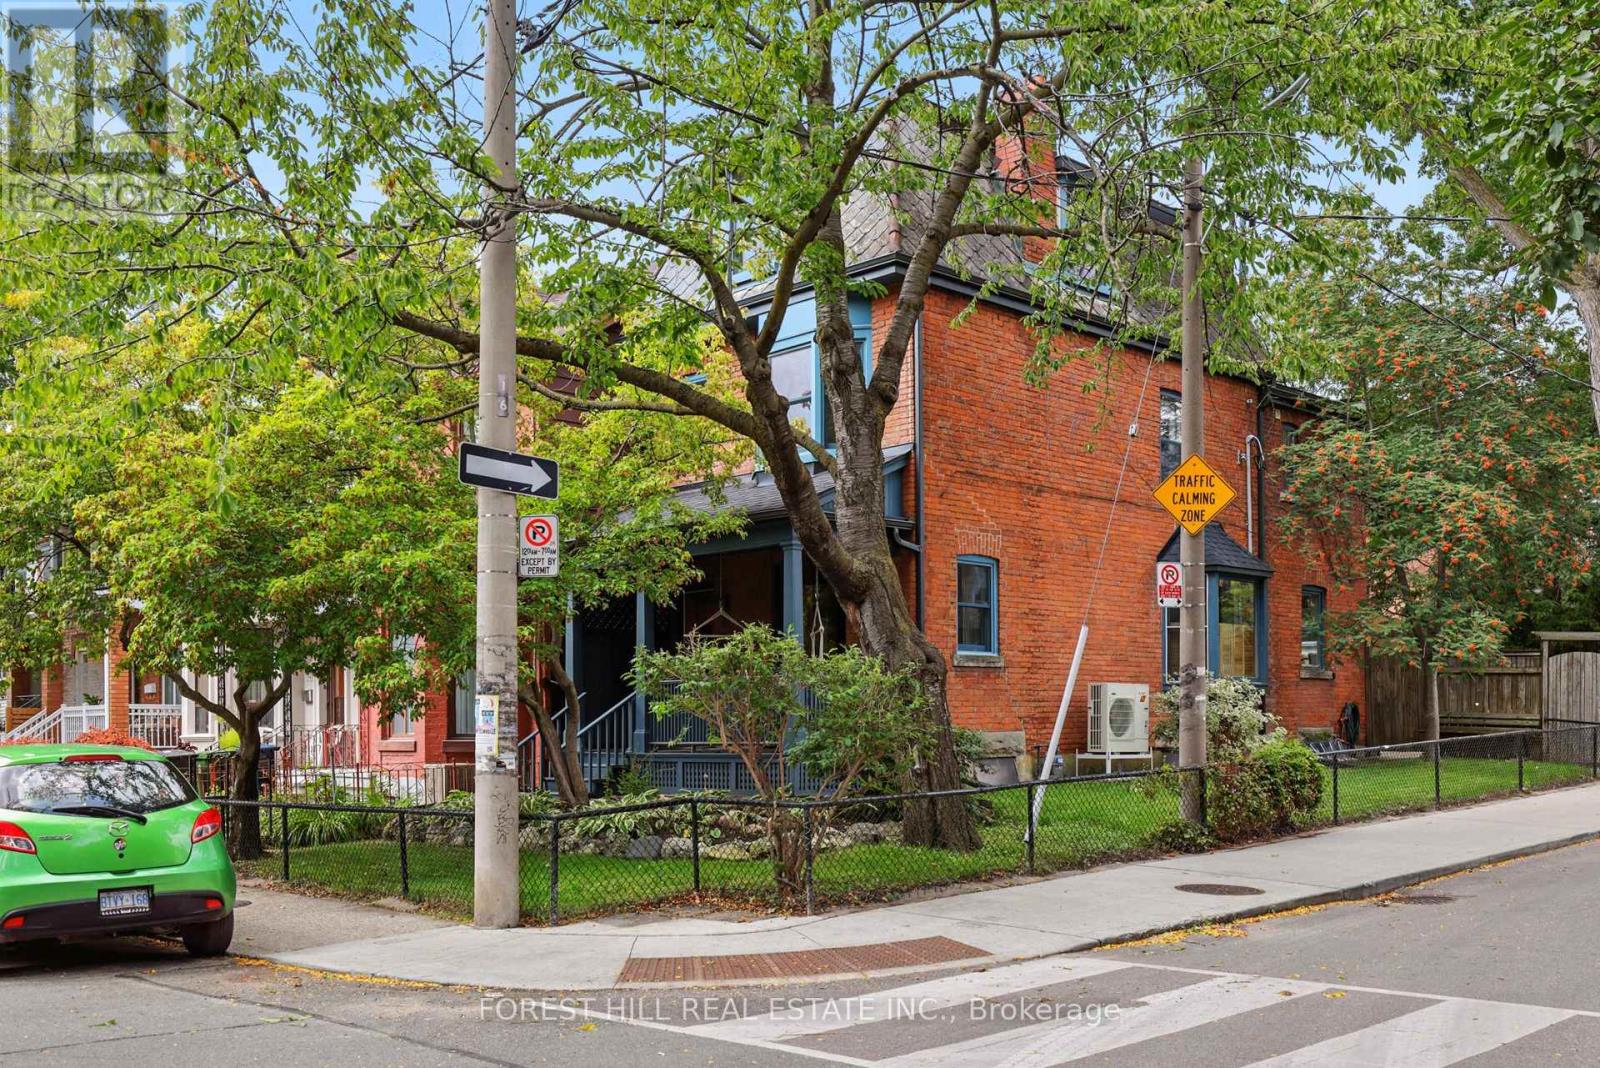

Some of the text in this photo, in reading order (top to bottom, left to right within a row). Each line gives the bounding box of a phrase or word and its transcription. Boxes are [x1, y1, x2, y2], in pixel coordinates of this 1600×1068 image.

[1174, 474, 1216, 488] TRAFFIC
[1172, 491, 1216, 505] CALMING
[1181, 509, 1206, 522] ZONE
[521, 556, 557, 567] EXCEPT BY
[527, 566, 551, 575] PERMIT
